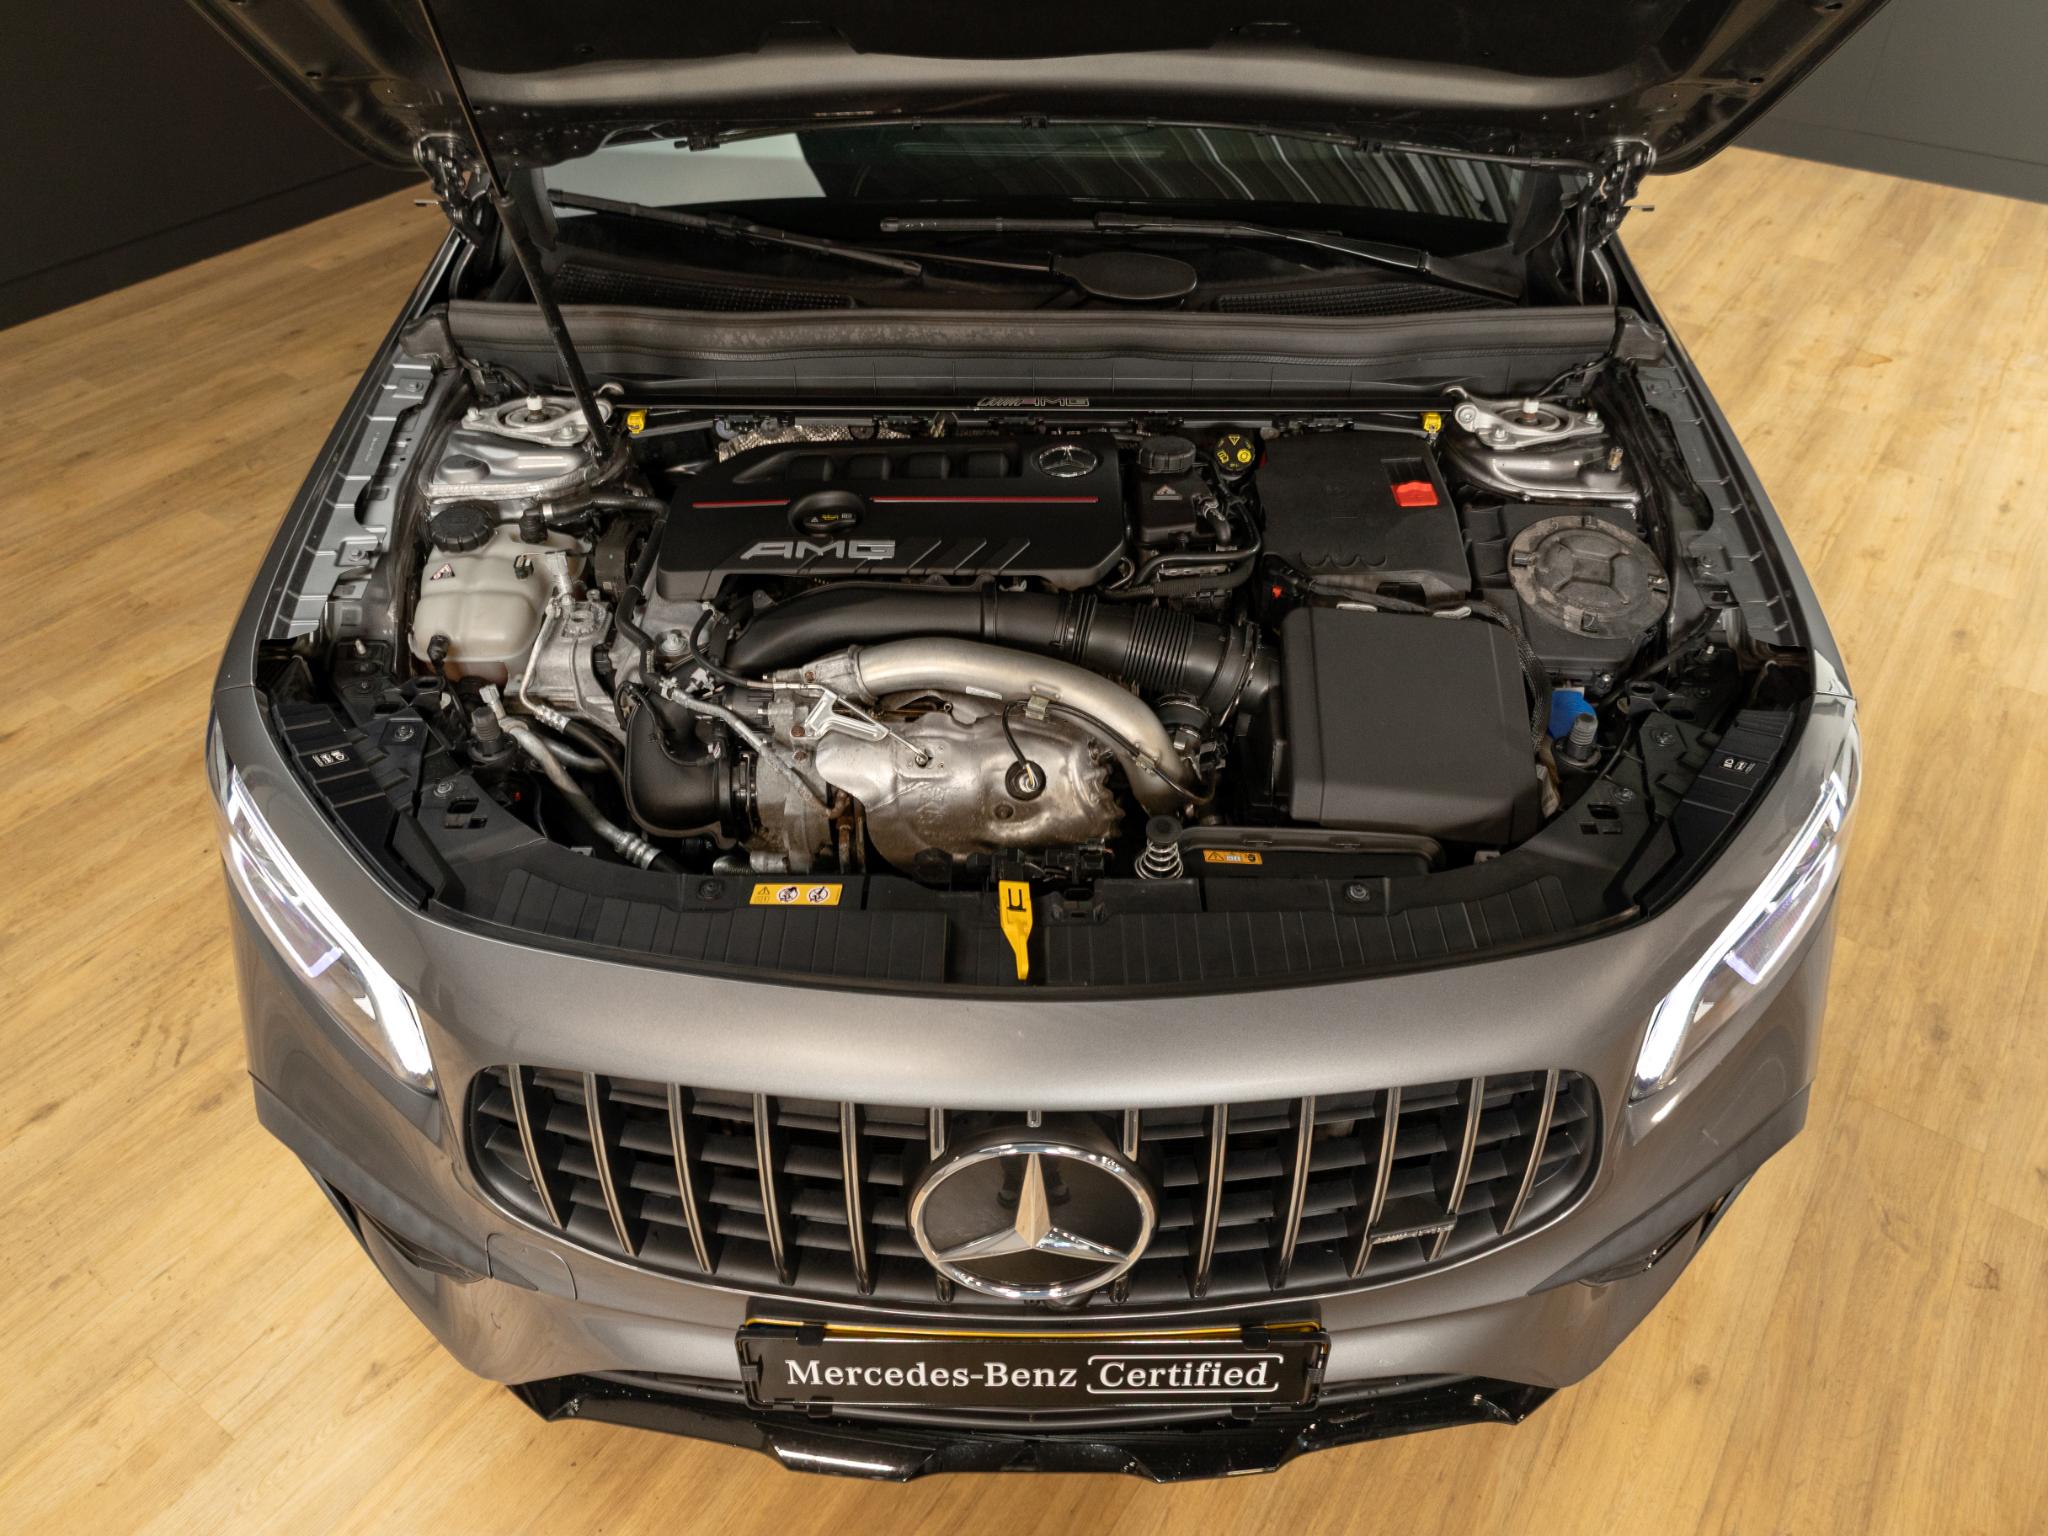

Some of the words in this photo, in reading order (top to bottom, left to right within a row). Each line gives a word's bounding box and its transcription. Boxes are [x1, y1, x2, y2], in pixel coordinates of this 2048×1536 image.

[739, 540, 896, 560] AMG
[784, 1359, 1078, 1387] Mercedes-Benz
[1098, 1361, 1268, 1387] Certified
